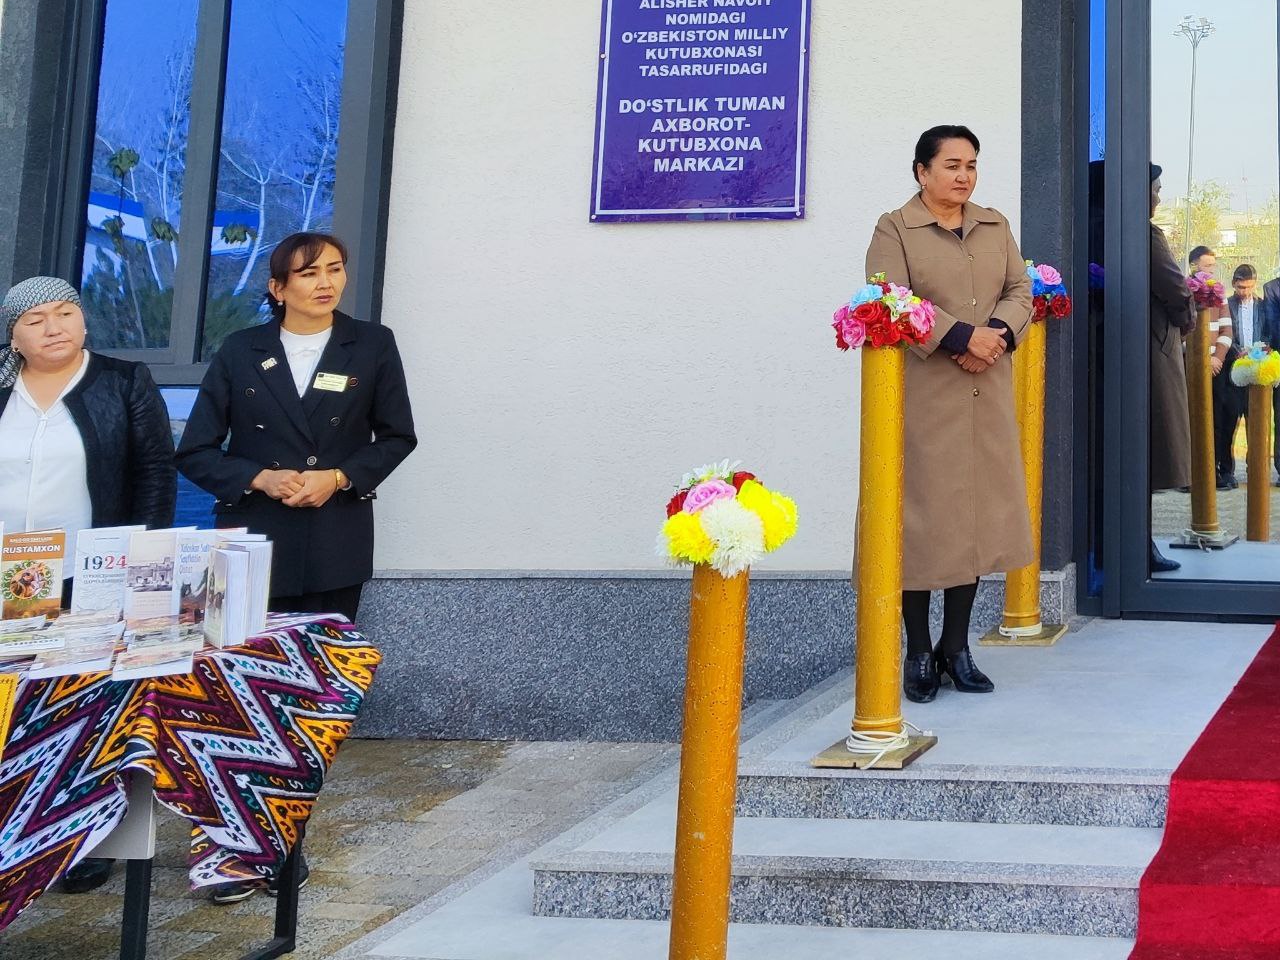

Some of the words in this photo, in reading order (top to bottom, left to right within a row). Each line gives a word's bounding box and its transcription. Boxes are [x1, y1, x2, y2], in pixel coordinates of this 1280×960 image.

[665, 11, 746, 26] NOMIDAGI
[734, 27, 789, 41] MILLIY
[645, 45, 763, 60] KUTUBXONASI
[638, 62, 768, 77] TASARRUFIDAGI
[714, 95, 786, 112] TUMAN
[650, 116, 751, 133] AXBOROT-
[638, 136, 763, 153] KUTUBXONA
[653, 156, 744, 173] MARKAZI
[3, 545, 60, 554] RUSTAMXON
[83, 555, 127, 571] 1924
